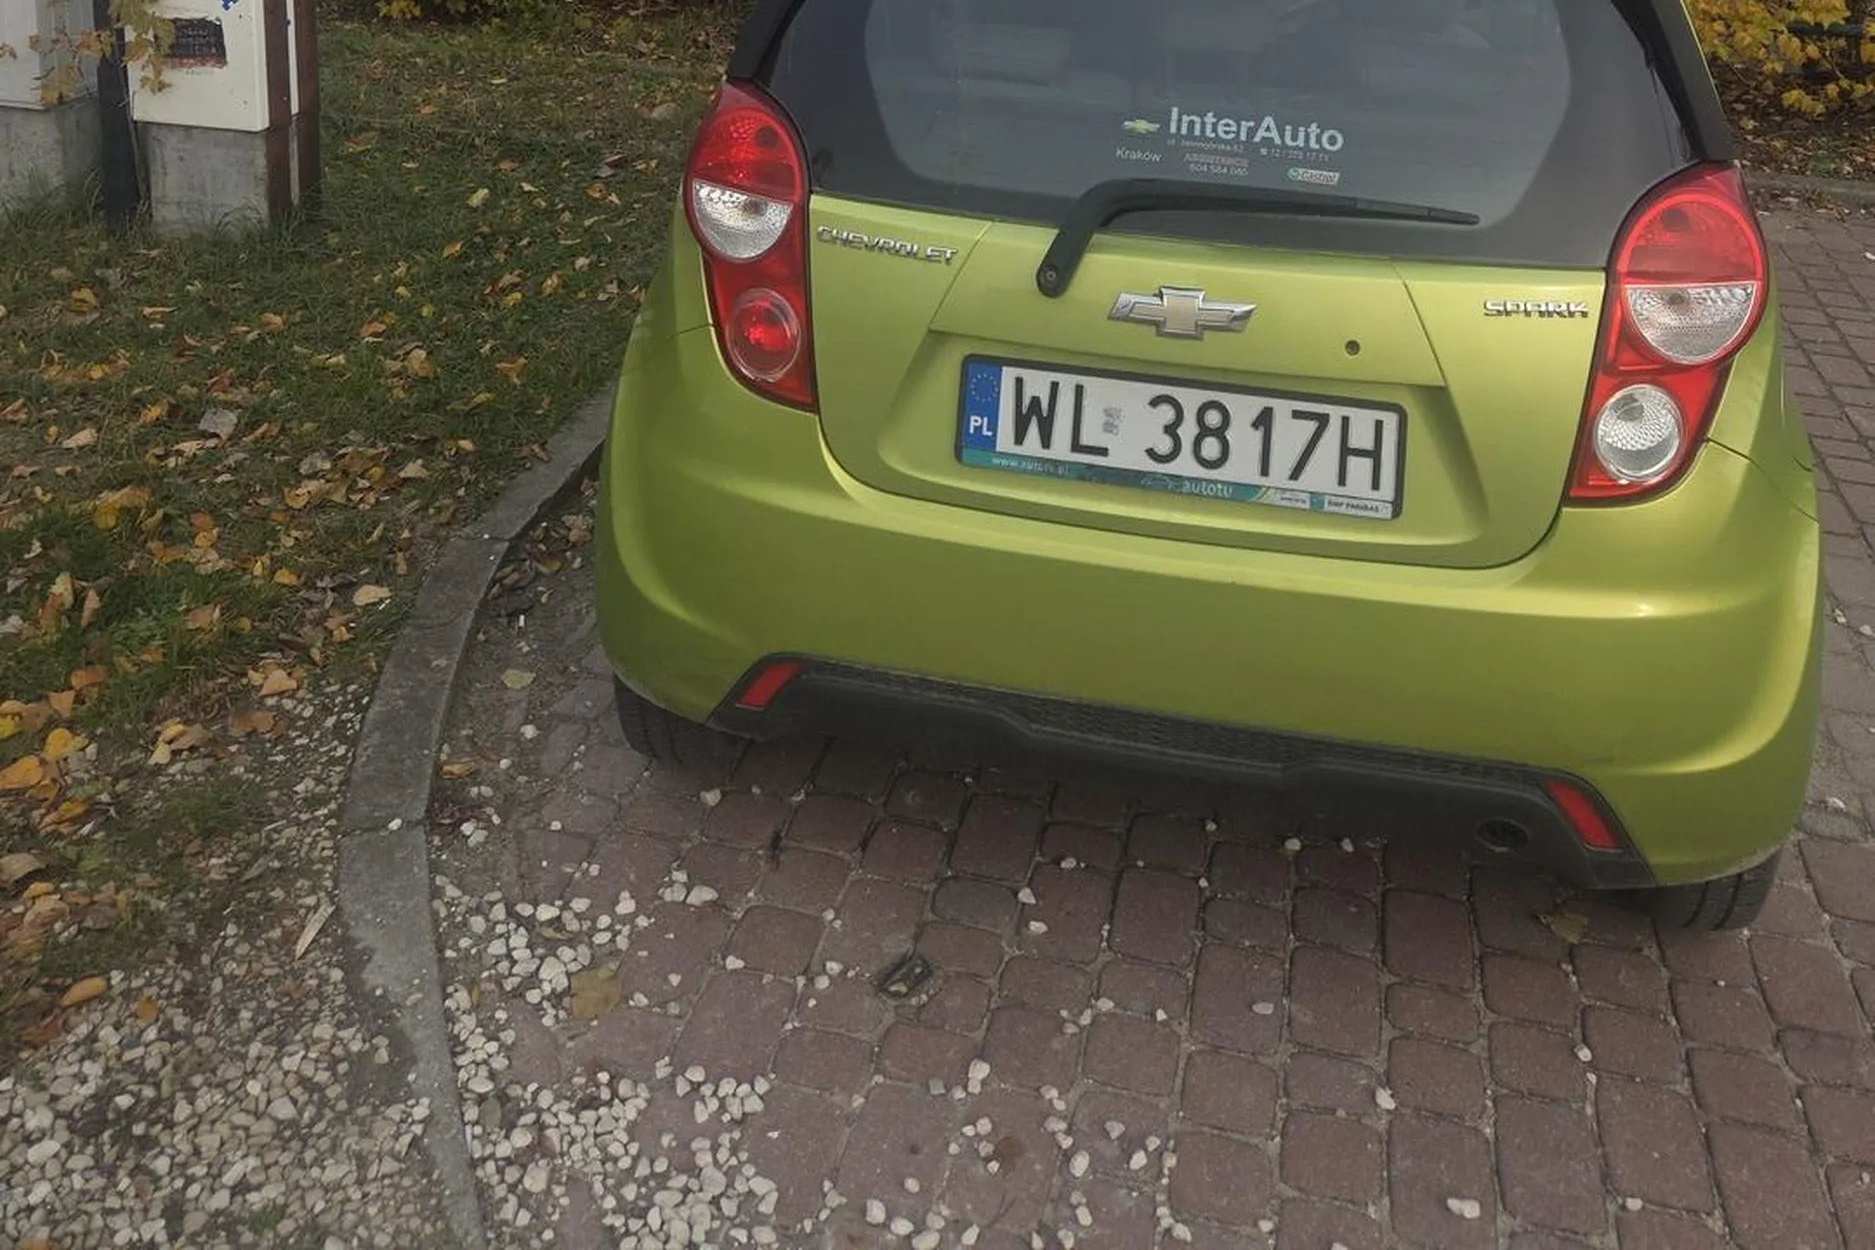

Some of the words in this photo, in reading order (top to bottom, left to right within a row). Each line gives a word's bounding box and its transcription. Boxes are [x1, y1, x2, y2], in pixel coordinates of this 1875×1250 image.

[1169, 106, 1344, 151] InterAuto
[1116, 146, 1162, 162] Kraków
[817, 225, 958, 265] CHEVROLET
[1484, 300, 1589, 318] SPARK
[969, 415, 993, 436] PL
[1014, 376, 1109, 457] WL
[1145, 394, 1384, 491] 3817H
